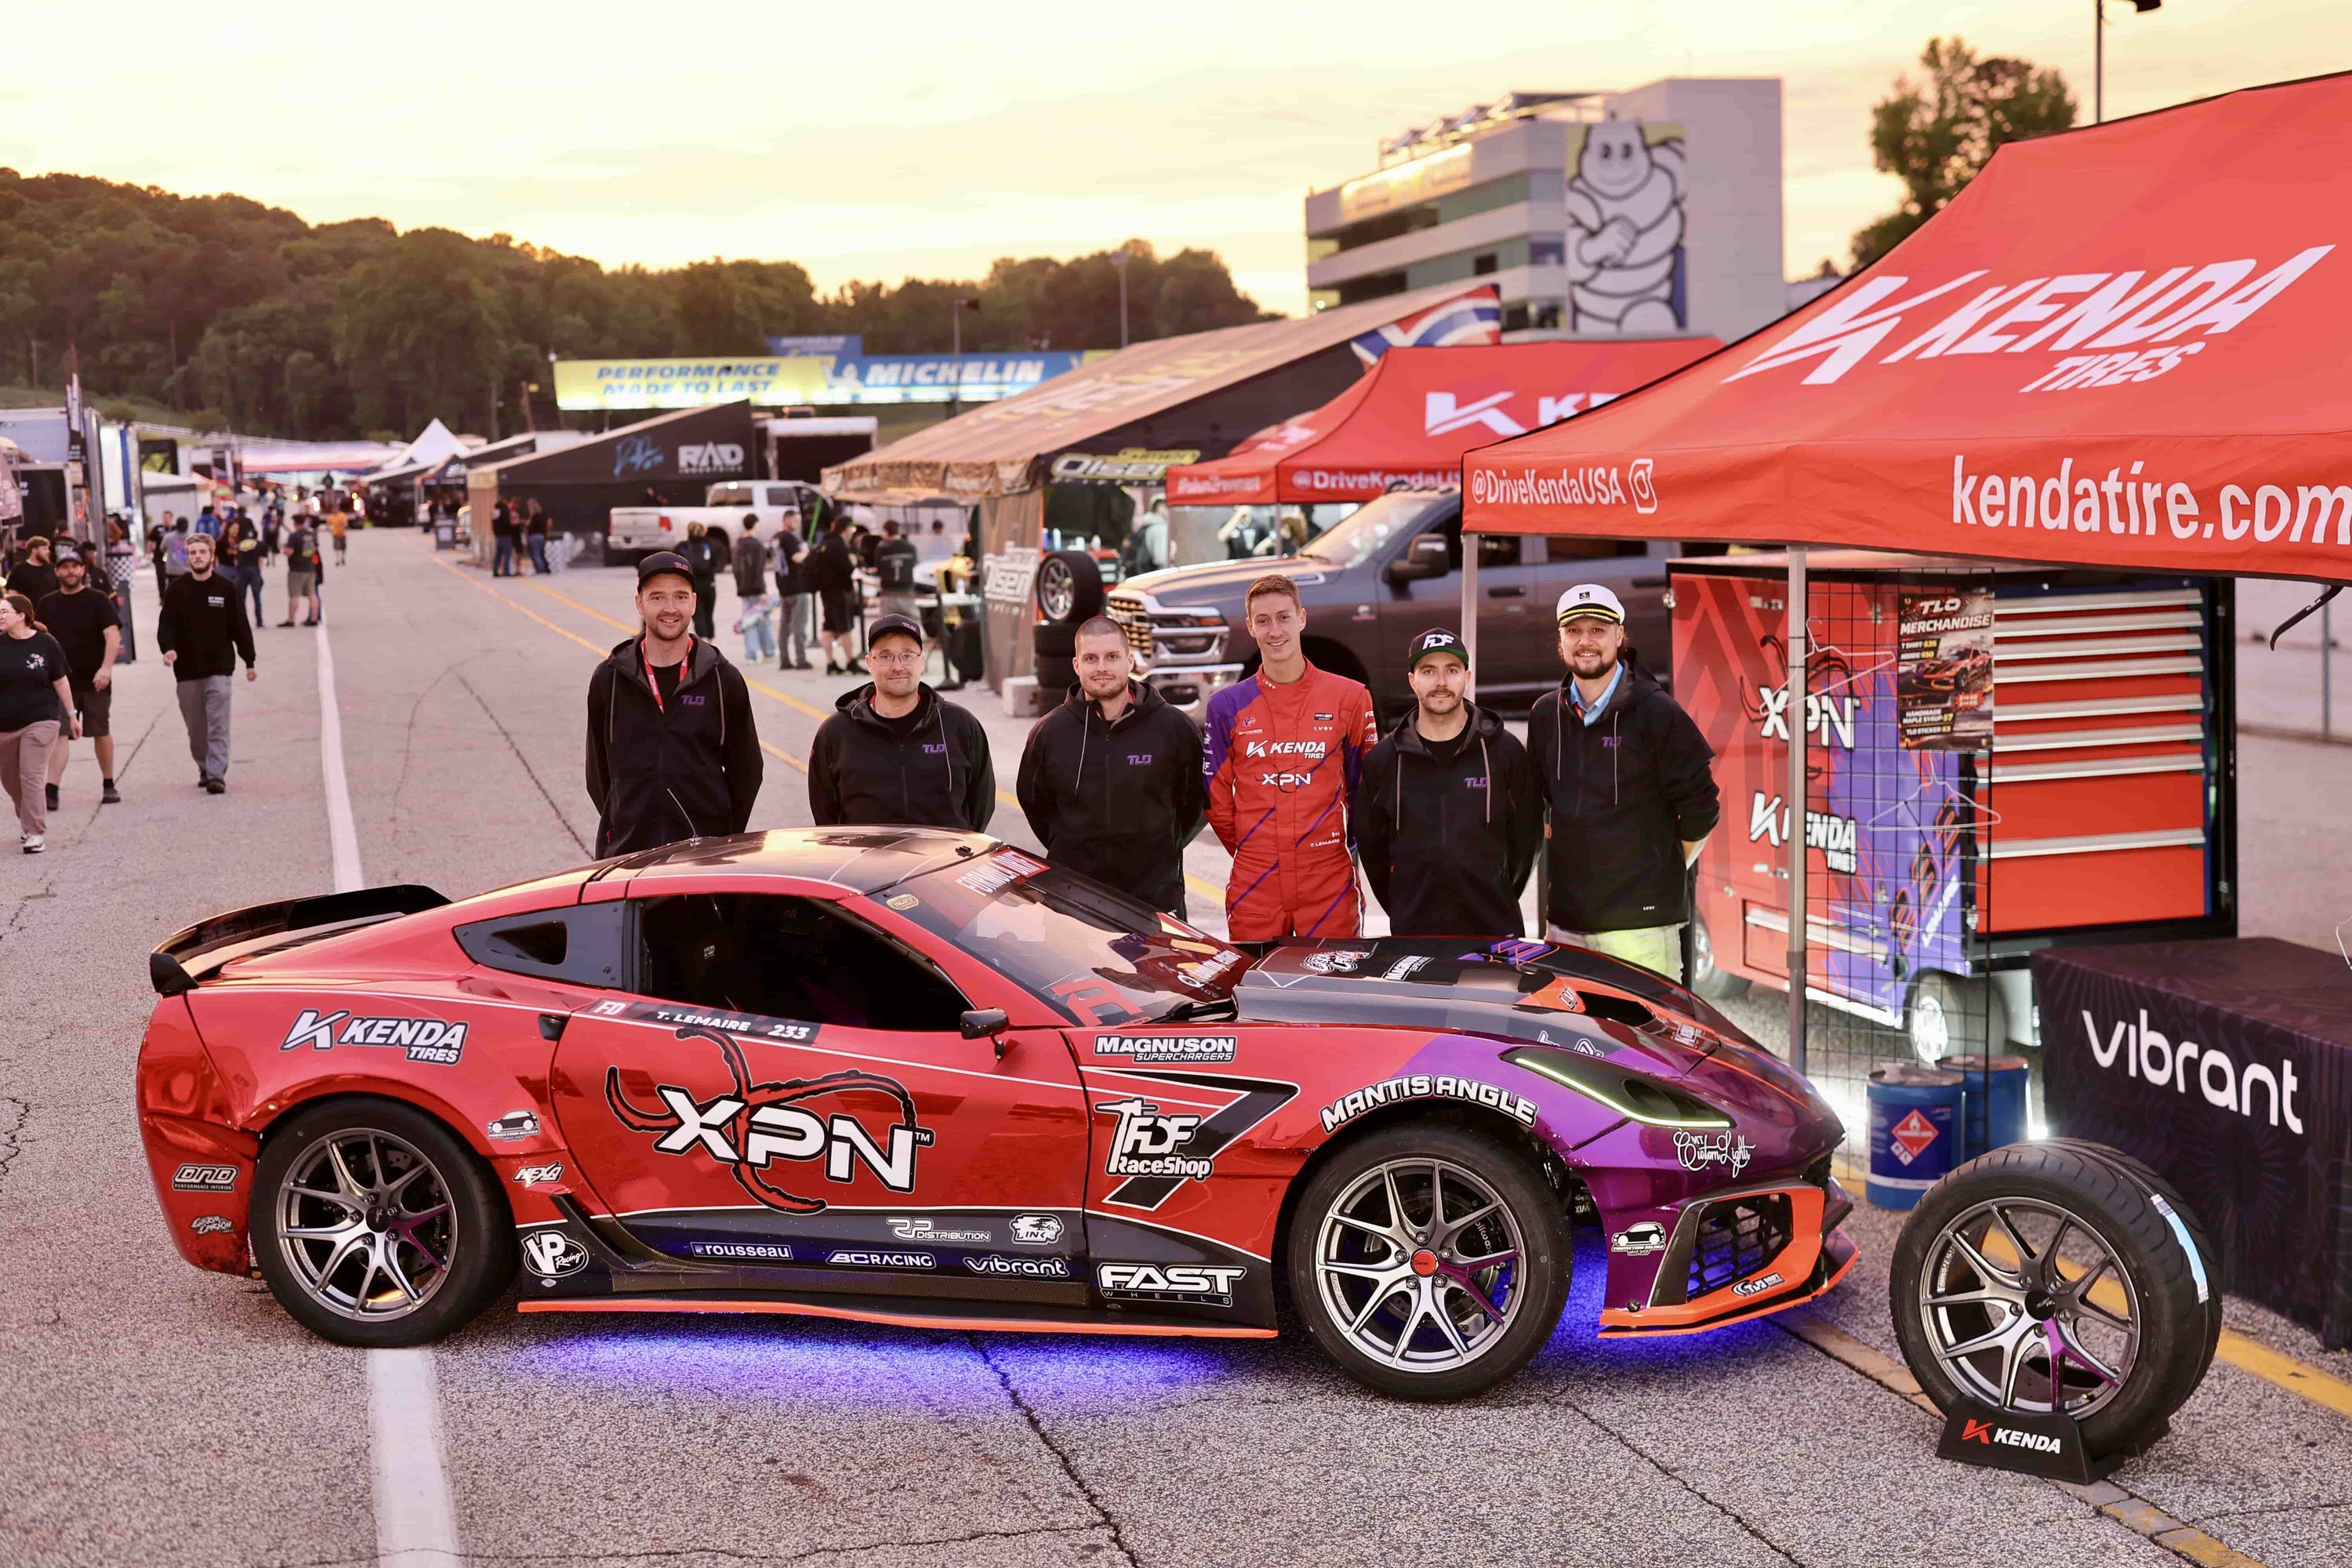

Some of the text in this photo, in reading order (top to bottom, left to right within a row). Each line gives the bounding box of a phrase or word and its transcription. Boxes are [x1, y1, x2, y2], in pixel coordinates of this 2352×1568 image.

[1880, 244, 2336, 364] KENDA
[597, 363, 780, 379] PERFORMANCE
[866, 361, 1045, 384] MICHELIN
[2018, 341, 2205, 392] TIRES
[603, 380, 773, 395] MADE TO LAST
[678, 441, 744, 468] RAD
[1472, 466, 1627, 506] @DriveKendaUSA
[1952, 454, 2352, 545] kendatire.com
[1919, 597, 1961, 615] TLO
[1900, 613, 1991, 635] MERCHANDISE
[1923, 714, 1943, 723] SYRUP
[1918, 726, 1942, 735] STICKER
[1269, 741, 1326, 754] KENDA
[1261, 773, 1311, 786] XPN
[1781, 806, 1857, 853] NDA
[592, 1001, 811, 1040] FD T. LEMAIRE 233
[339, 1018, 466, 1049] KENDA
[407, 1046, 459, 1063] TIRES
[1096, 1037, 1234, 1053] MAGNUSON
[1135, 1051, 1232, 1062] SUPERCHARGERS
[2081, 1009, 2304, 1134] vibrant
[1324, 1077, 1537, 1130] MANTIS ANGLE
[654, 1087, 916, 1191] XPN
[1123, 1116, 1199, 1154] FDF
[1116, 1156, 1210, 1178] RaceShop
[918, 1230, 990, 1242] DISTRIBUTION
[1016, 1229, 1046, 1240] LINK
[526, 1234, 584, 1274] VP Racing
[706, 1243, 789, 1259] rousseau
[967, 1257, 1068, 1276] vibrant
[1101, 1266, 1243, 1293] FAST
[1103, 1291, 1229, 1304] WHEELS
[1993, 1428, 2062, 1454] KENDA
